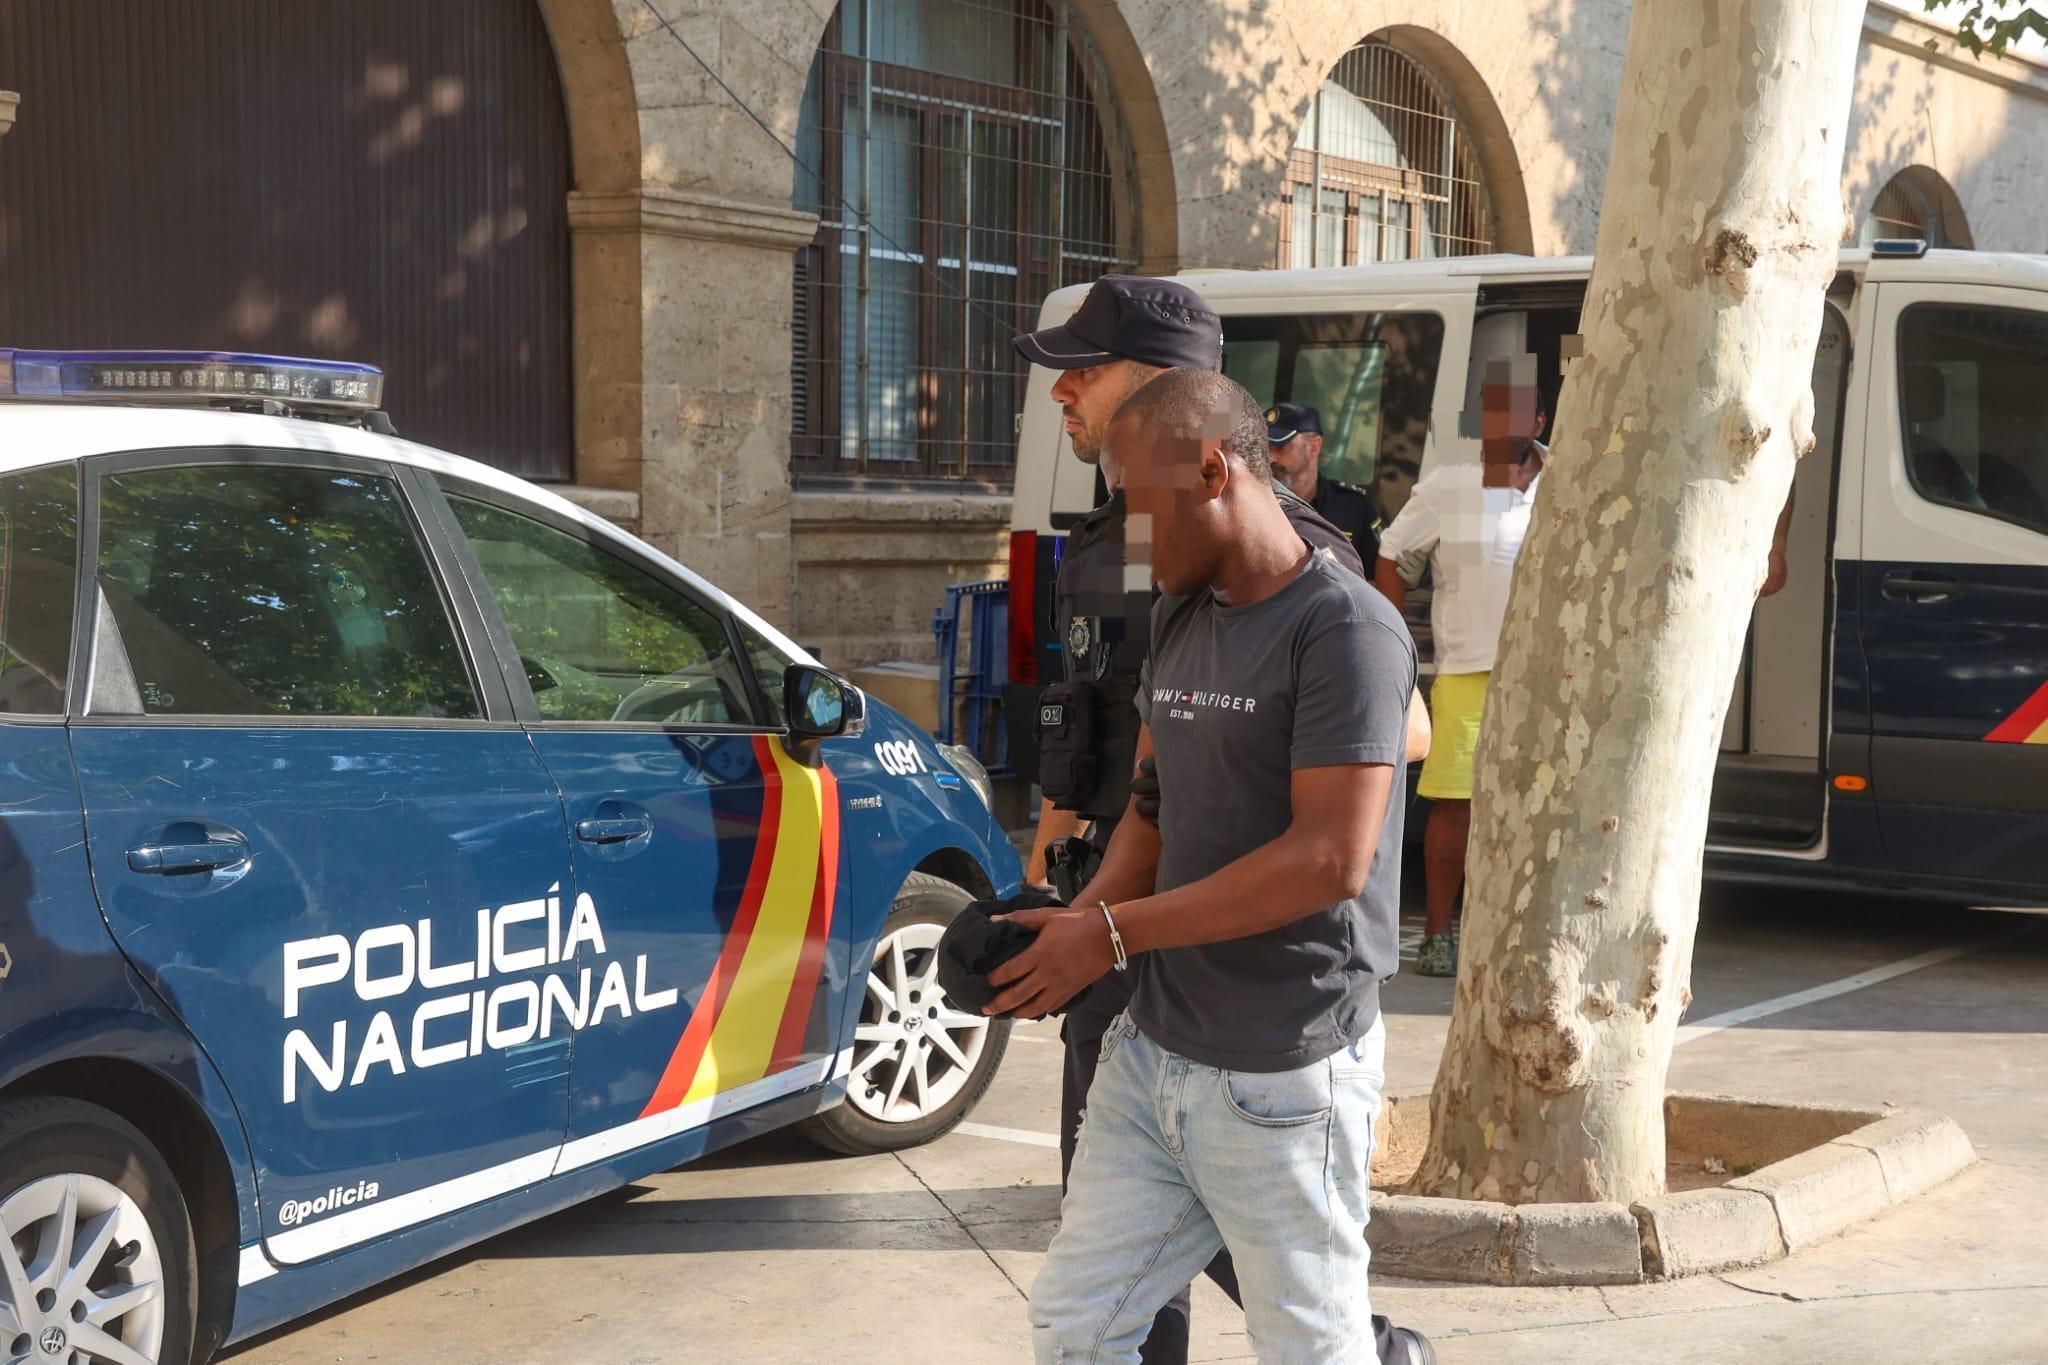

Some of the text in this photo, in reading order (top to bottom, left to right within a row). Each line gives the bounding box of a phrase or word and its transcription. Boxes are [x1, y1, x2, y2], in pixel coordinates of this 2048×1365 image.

[1152, 688, 1256, 713] OMMY HILFIGER
[284, 881, 606, 1018] POLICÍA
[284, 955, 678, 1104] NACIONAL
[279, 1180, 379, 1225] @policia
